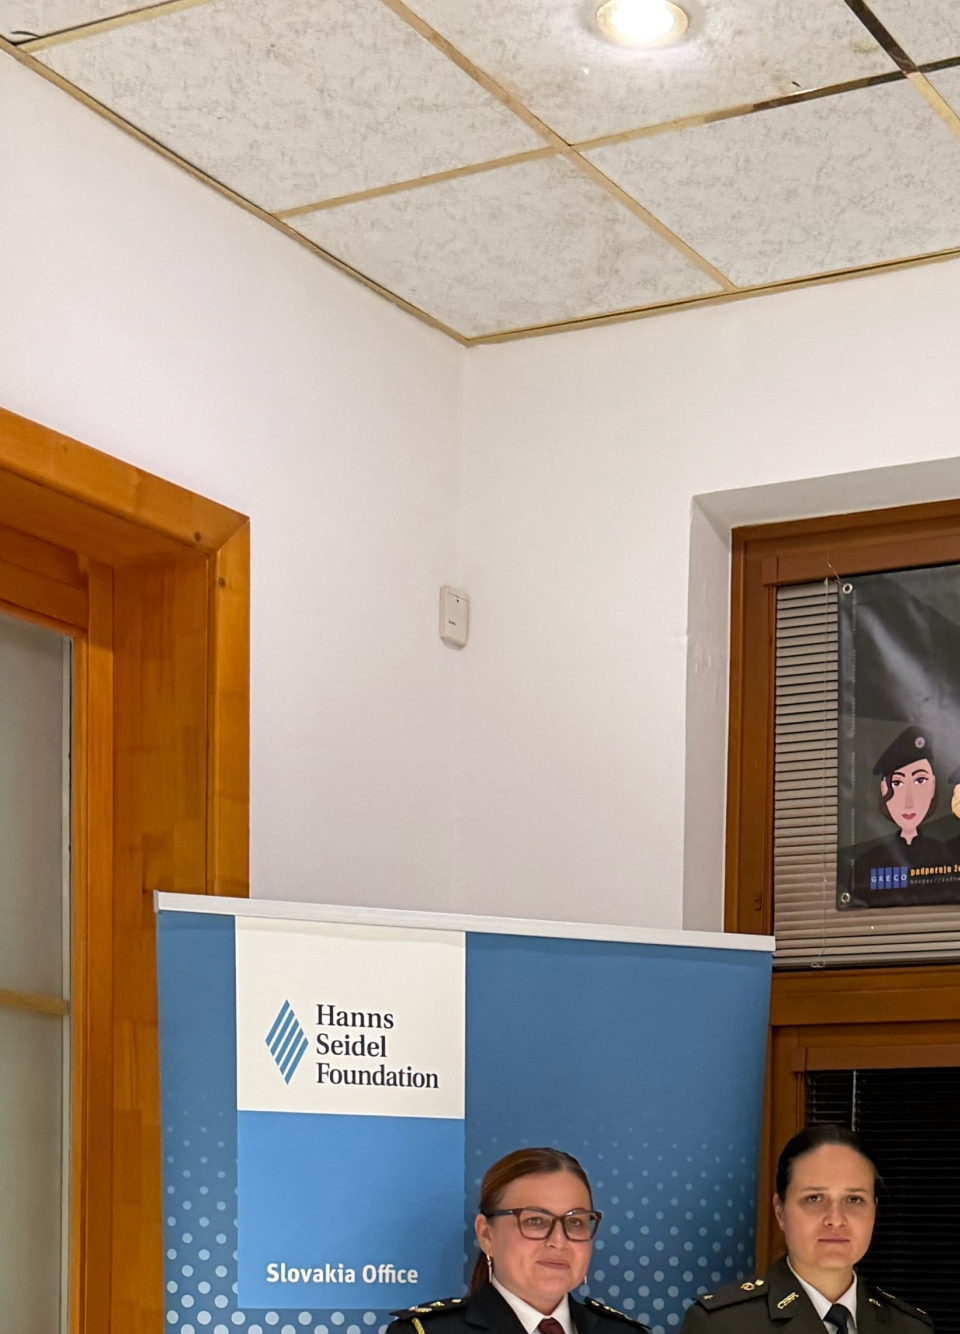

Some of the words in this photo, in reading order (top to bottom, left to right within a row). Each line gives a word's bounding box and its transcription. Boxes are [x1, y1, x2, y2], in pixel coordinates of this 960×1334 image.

[871, 873, 908, 883] GRECO
[315, 1003, 394, 1030] Hanns
[315, 1033, 387, 1058] Seidel
[315, 1062, 439, 1089] Foundation
[266, 1262, 355, 1284] Slovakia
[362, 1263, 418, 1284] Office
